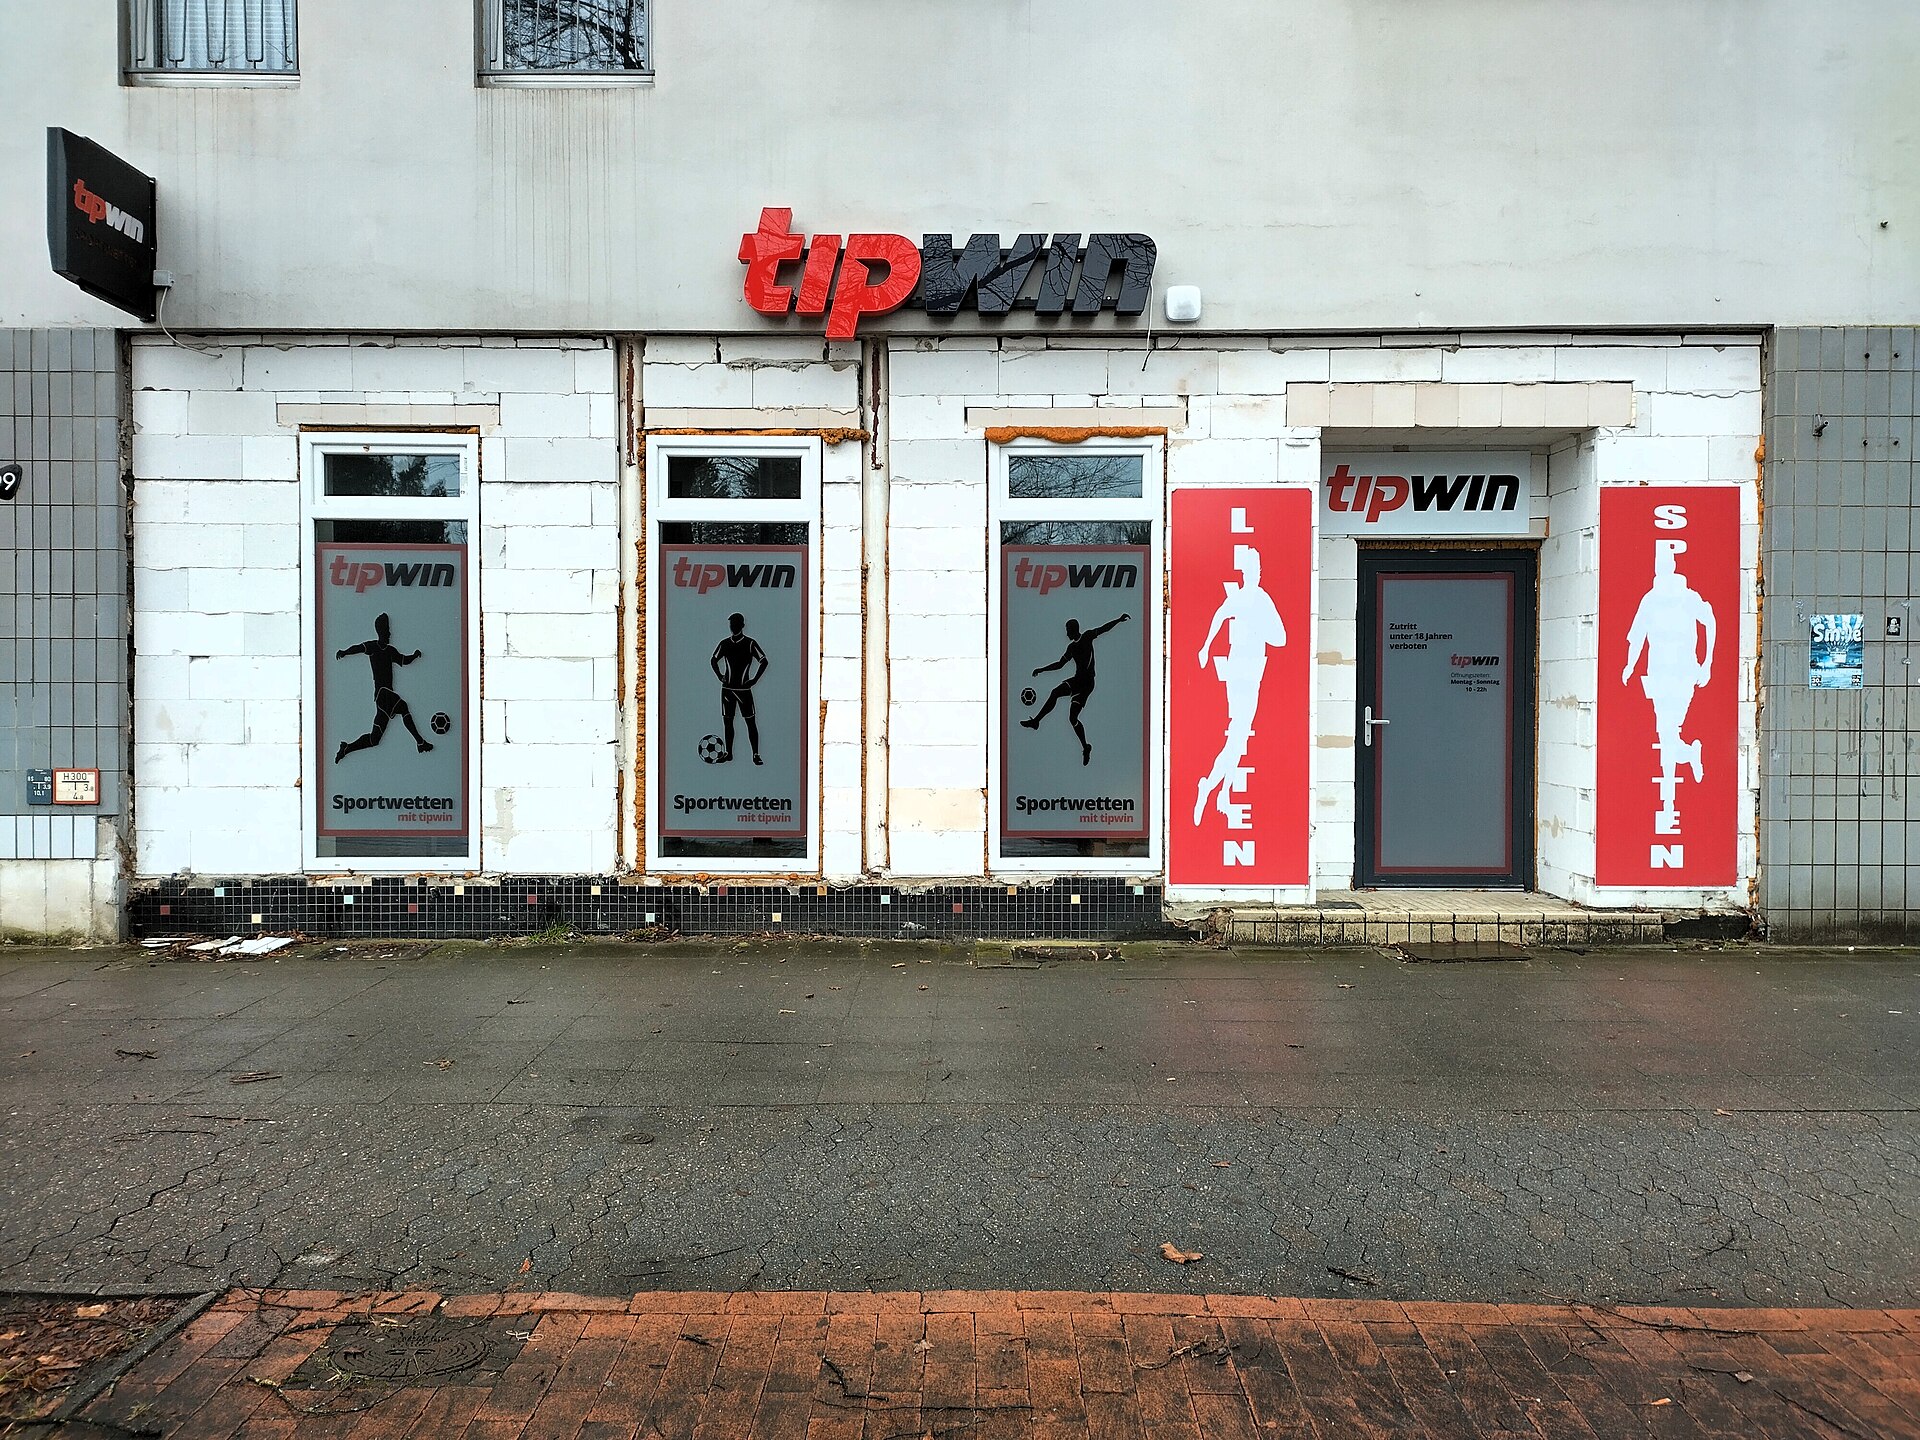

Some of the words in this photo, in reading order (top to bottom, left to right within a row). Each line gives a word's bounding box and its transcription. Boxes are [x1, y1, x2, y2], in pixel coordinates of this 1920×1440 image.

[73, 178, 144, 243] tipwin
[738, 207, 1157, 342] tipwin
[0, 472, 16, 491] 9
[1326, 464, 1520, 523] tipwin
[329, 555, 455, 593] tipwin
[672, 556, 796, 595] tipwin
[1014, 557, 1138, 596] tipwin
[1389, 622, 1418, 631] Zutritt
[1389, 642, 1428, 650] verboten
[1425, 632, 1453, 642] Jahren
[1450, 653, 1500, 669] tipwin
[63, 772, 87, 781] H300
[332, 794, 454, 814] Sportwetten
[673, 794, 793, 815] Sportwetten
[1015, 795, 1135, 816] Sportwetten
[397, 811, 417, 822] mit
[419, 811, 453, 824] tipwin
[737, 812, 756, 823] mit
[757, 812, 792, 825] tipwin
[1079, 812, 1099, 823] mit
[1100, 812, 1134, 825] tipwin
